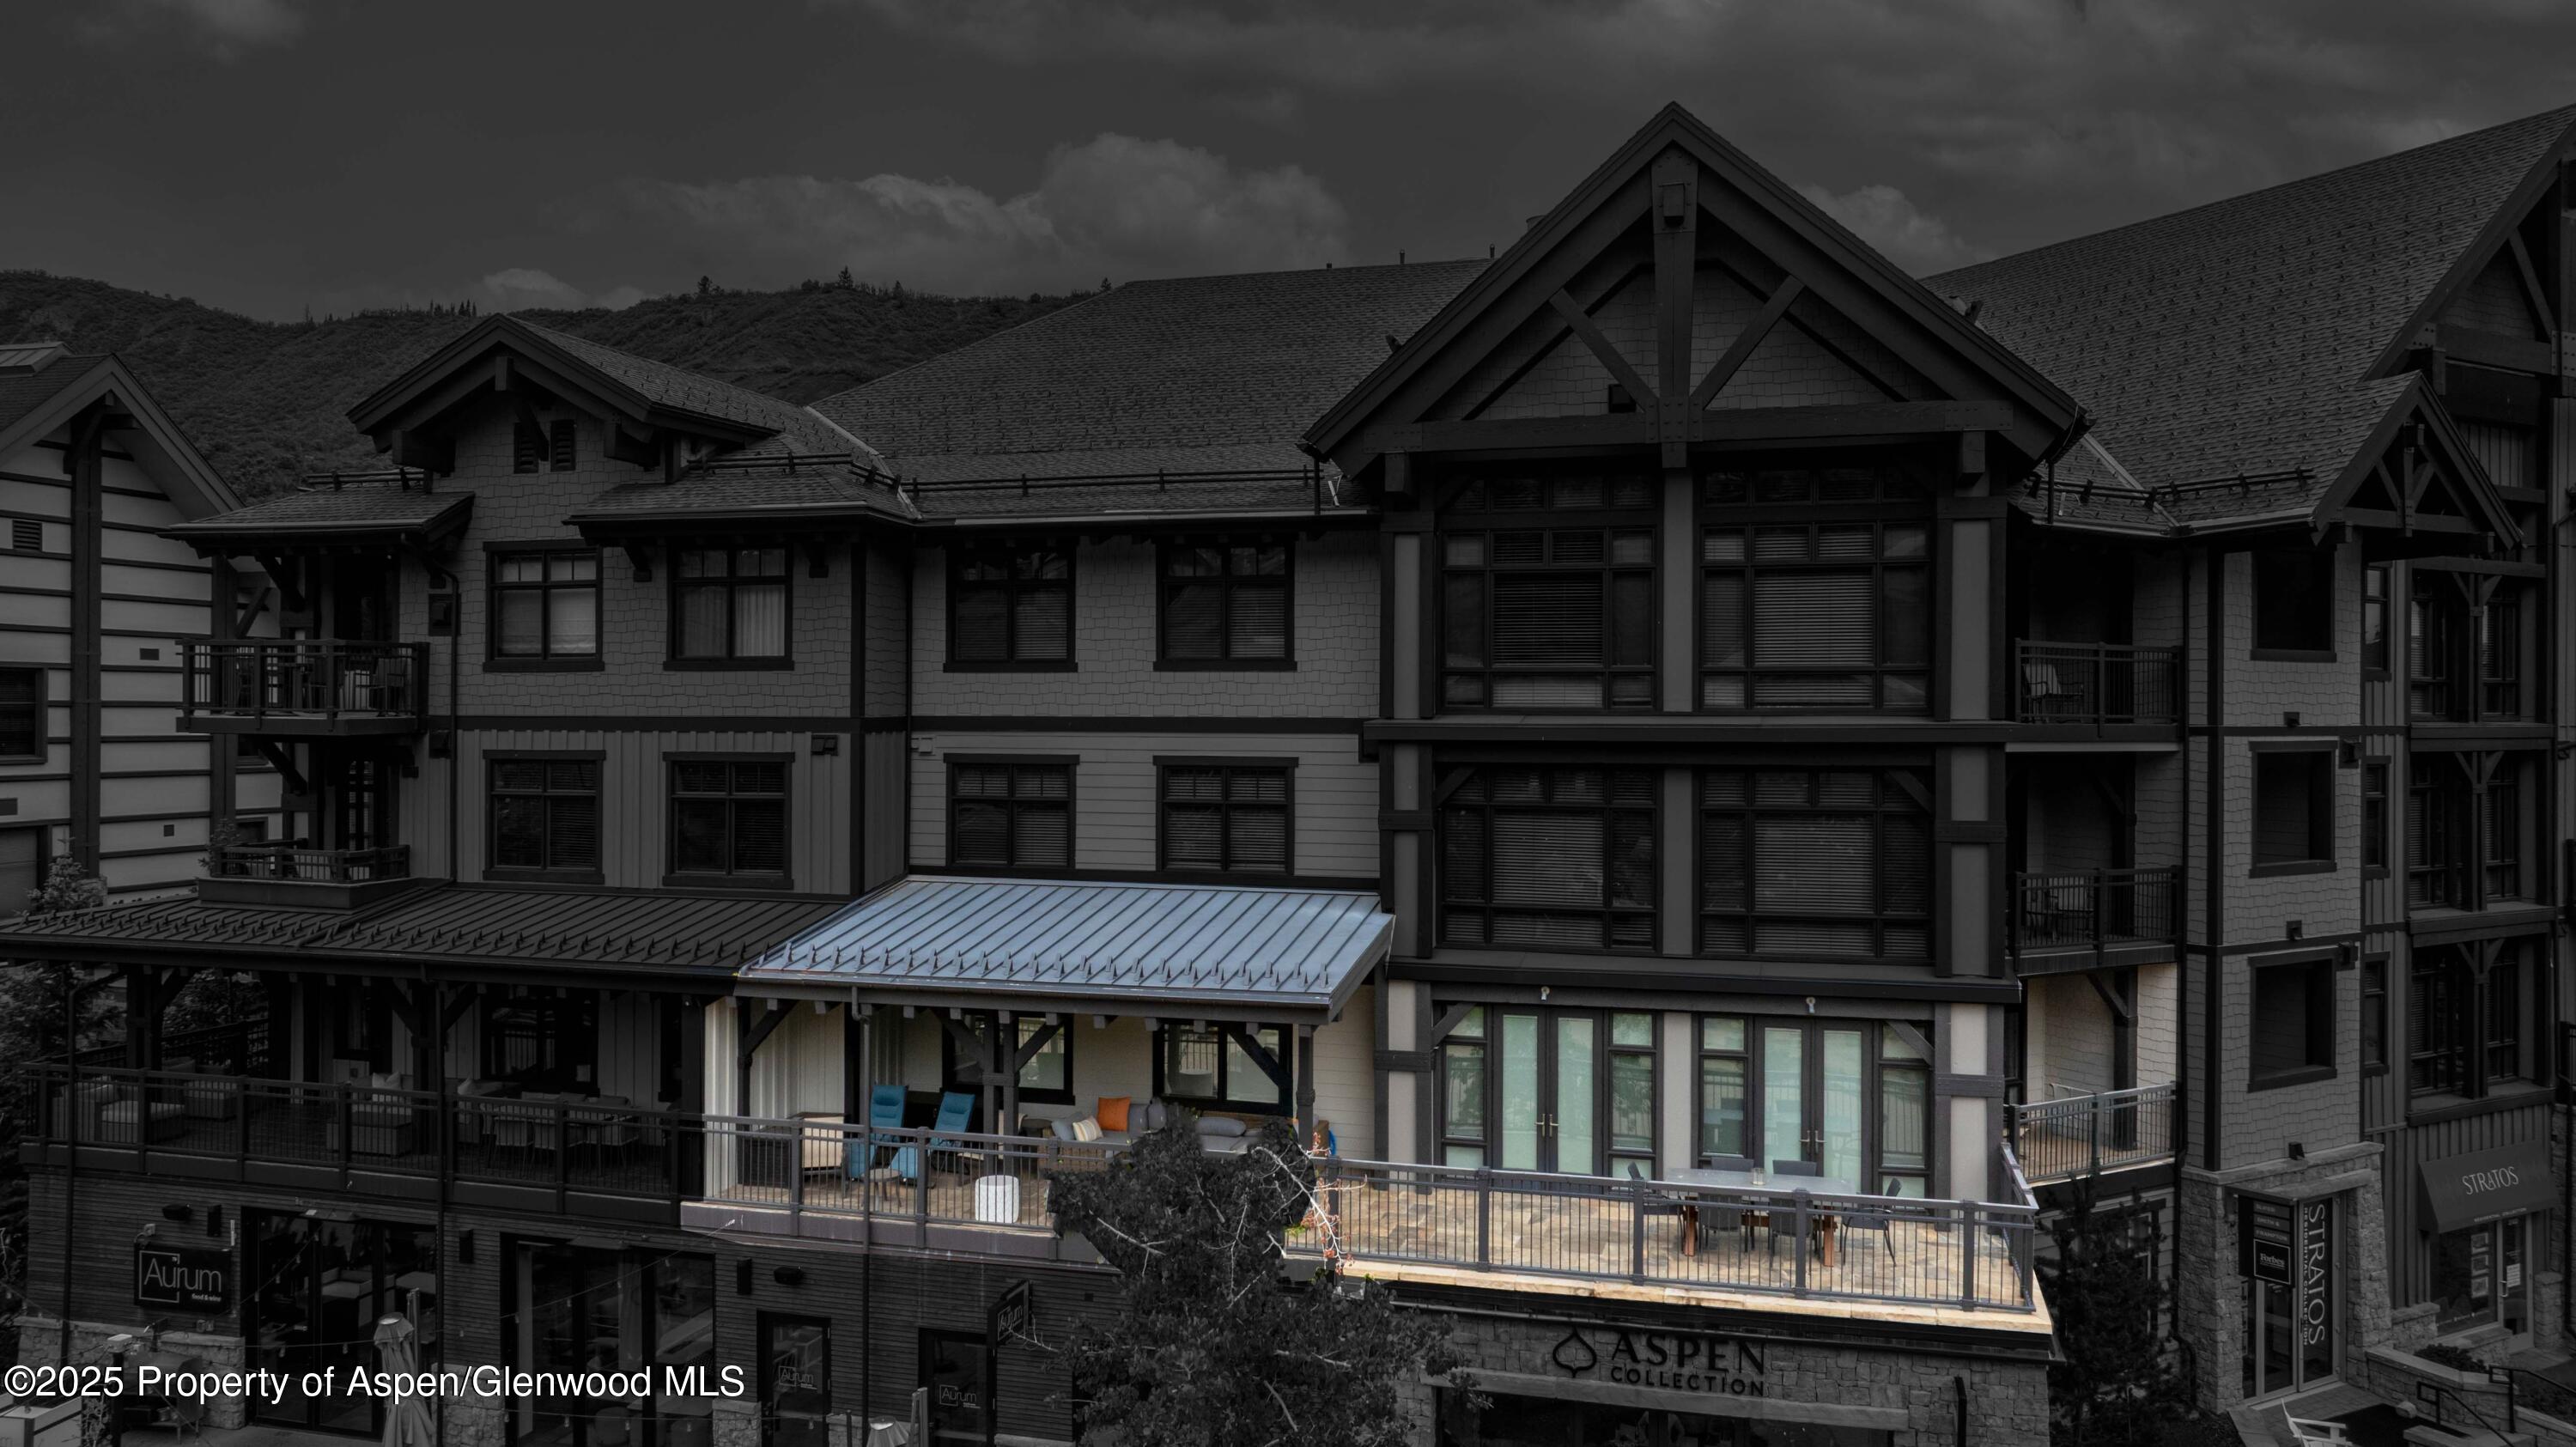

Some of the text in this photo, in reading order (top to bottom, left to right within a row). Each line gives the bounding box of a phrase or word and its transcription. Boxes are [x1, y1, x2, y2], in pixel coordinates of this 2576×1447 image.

[2462, 1166, 2519, 1195] STRATOS
[144, 1257, 222, 1292] Aurum
[2307, 1203, 2325, 1345] STRATOS
[1611, 1333, 1765, 1375] ASPEN
[781, 1368, 814, 1384] Aurum
[1610, 1365, 1765, 1397] COLLECTION
[941, 1387, 977, 1402] Aurum
